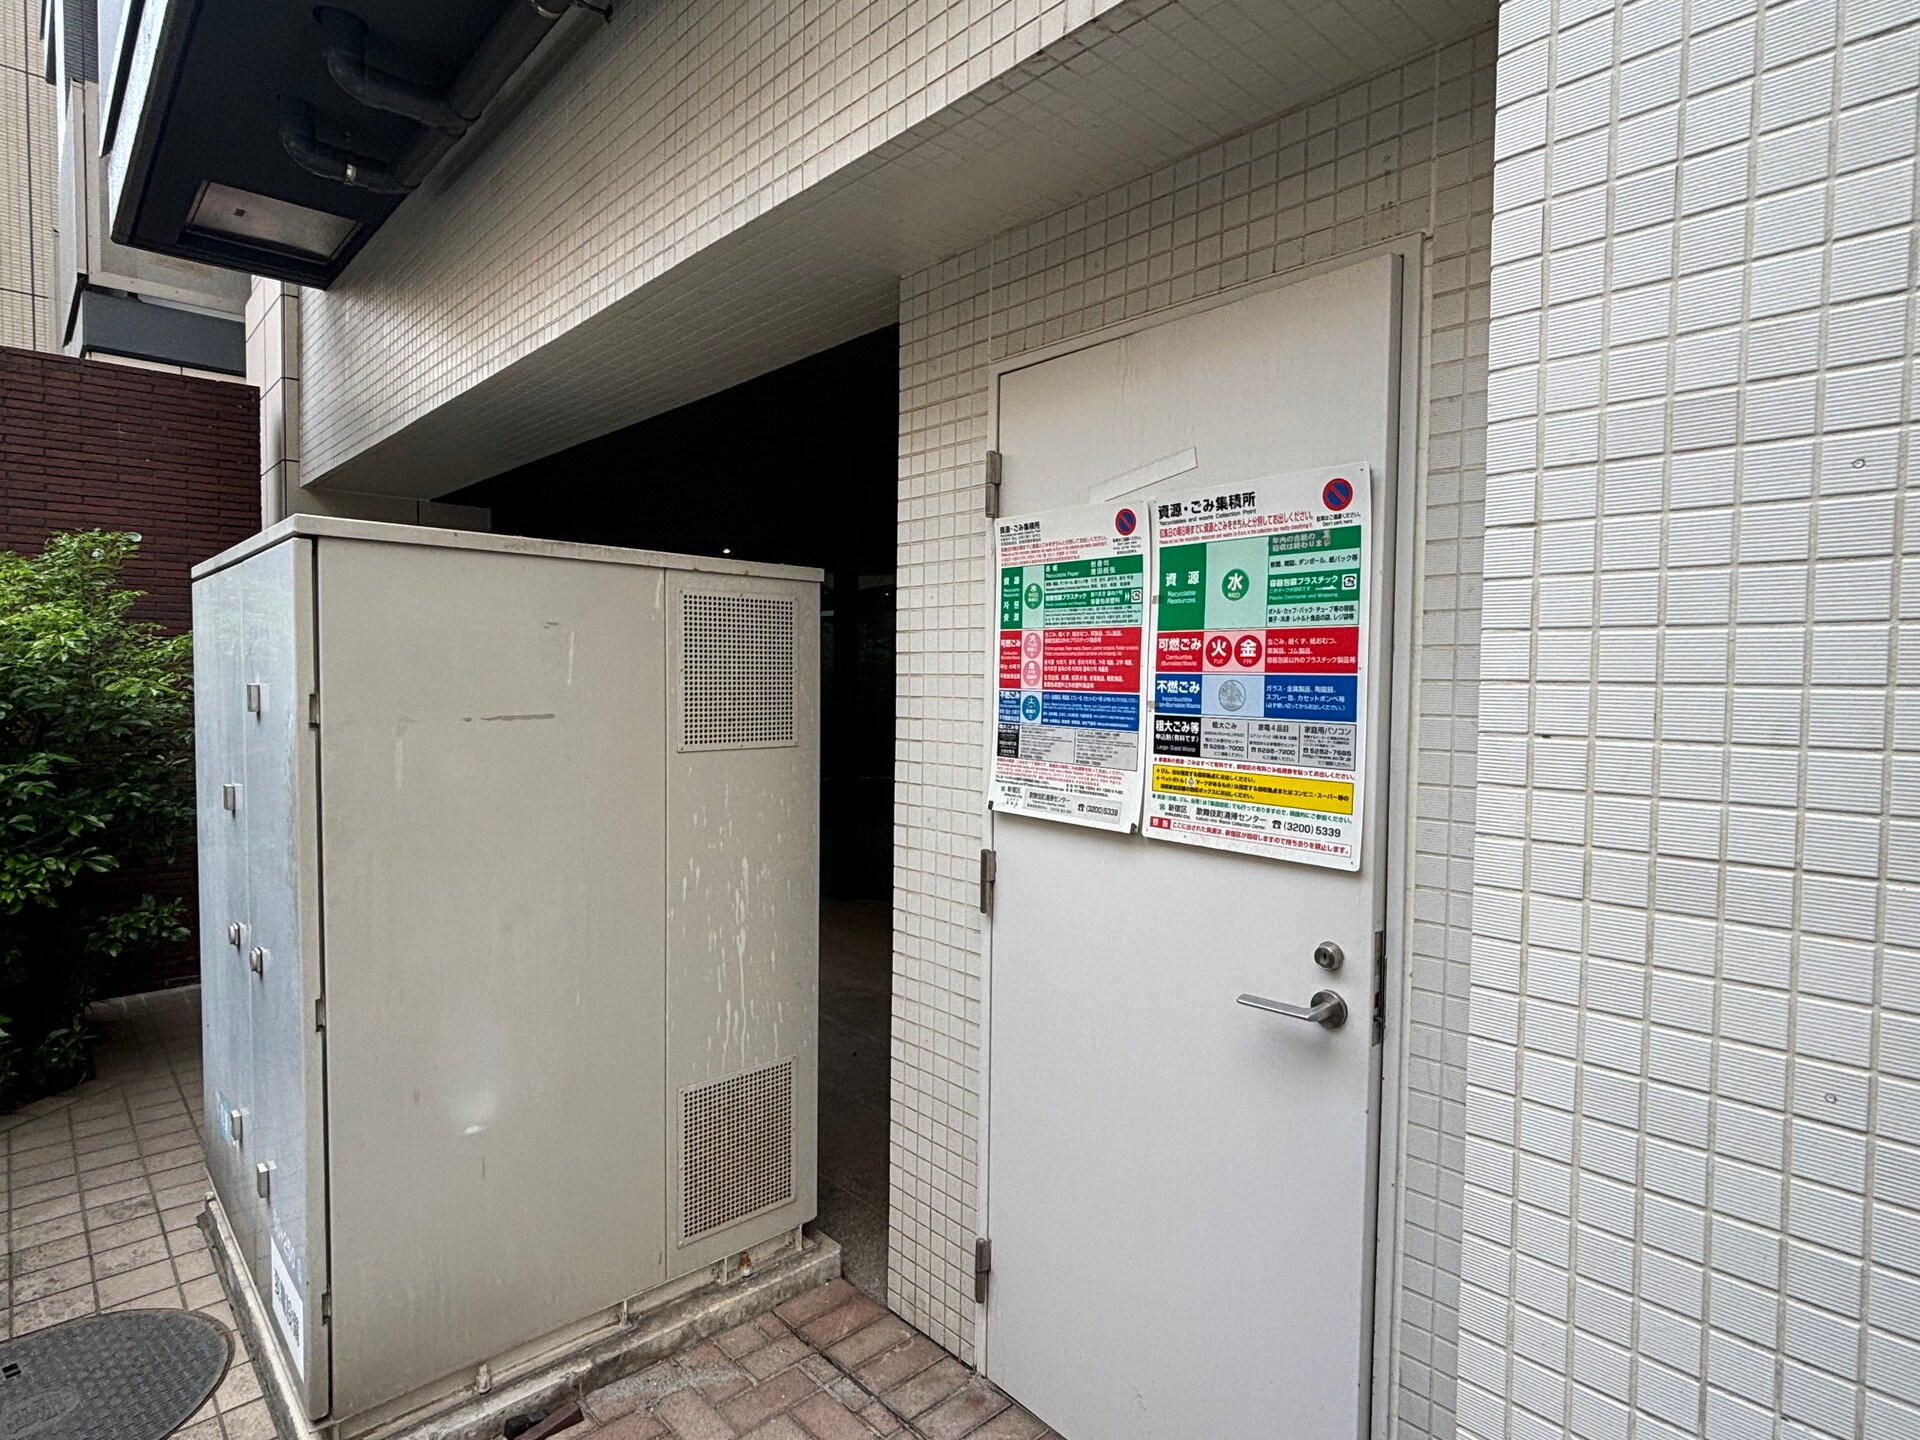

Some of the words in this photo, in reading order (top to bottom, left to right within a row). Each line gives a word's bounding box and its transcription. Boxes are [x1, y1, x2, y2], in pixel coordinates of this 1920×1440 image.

[1158, 491, 1255, 519] 資源・ごみ集積所
[1215, 511, 1240, 519] Collection
[1000, 521, 1040, 534] 資源・ごみ集積所
[1165, 571, 1200, 587] 資源
[1227, 573, 1243, 591] 水
[1269, 575, 1339, 588] 容器包装プラスチック
[1158, 638, 1202, 652] 可燃ごみ
[1211, 640, 1226, 657] 火
[1240, 639, 1257, 657] 金
[1157, 680, 1200, 694] 不燃ごみ
[1155, 719, 1200, 734] 粗大ごみ等
[1212, 721, 1237, 730] 粗大ごみ
[1168, 803, 1187, 813] 新宿区
[1196, 807, 1267, 823] 歌舞伎町清掃センター
